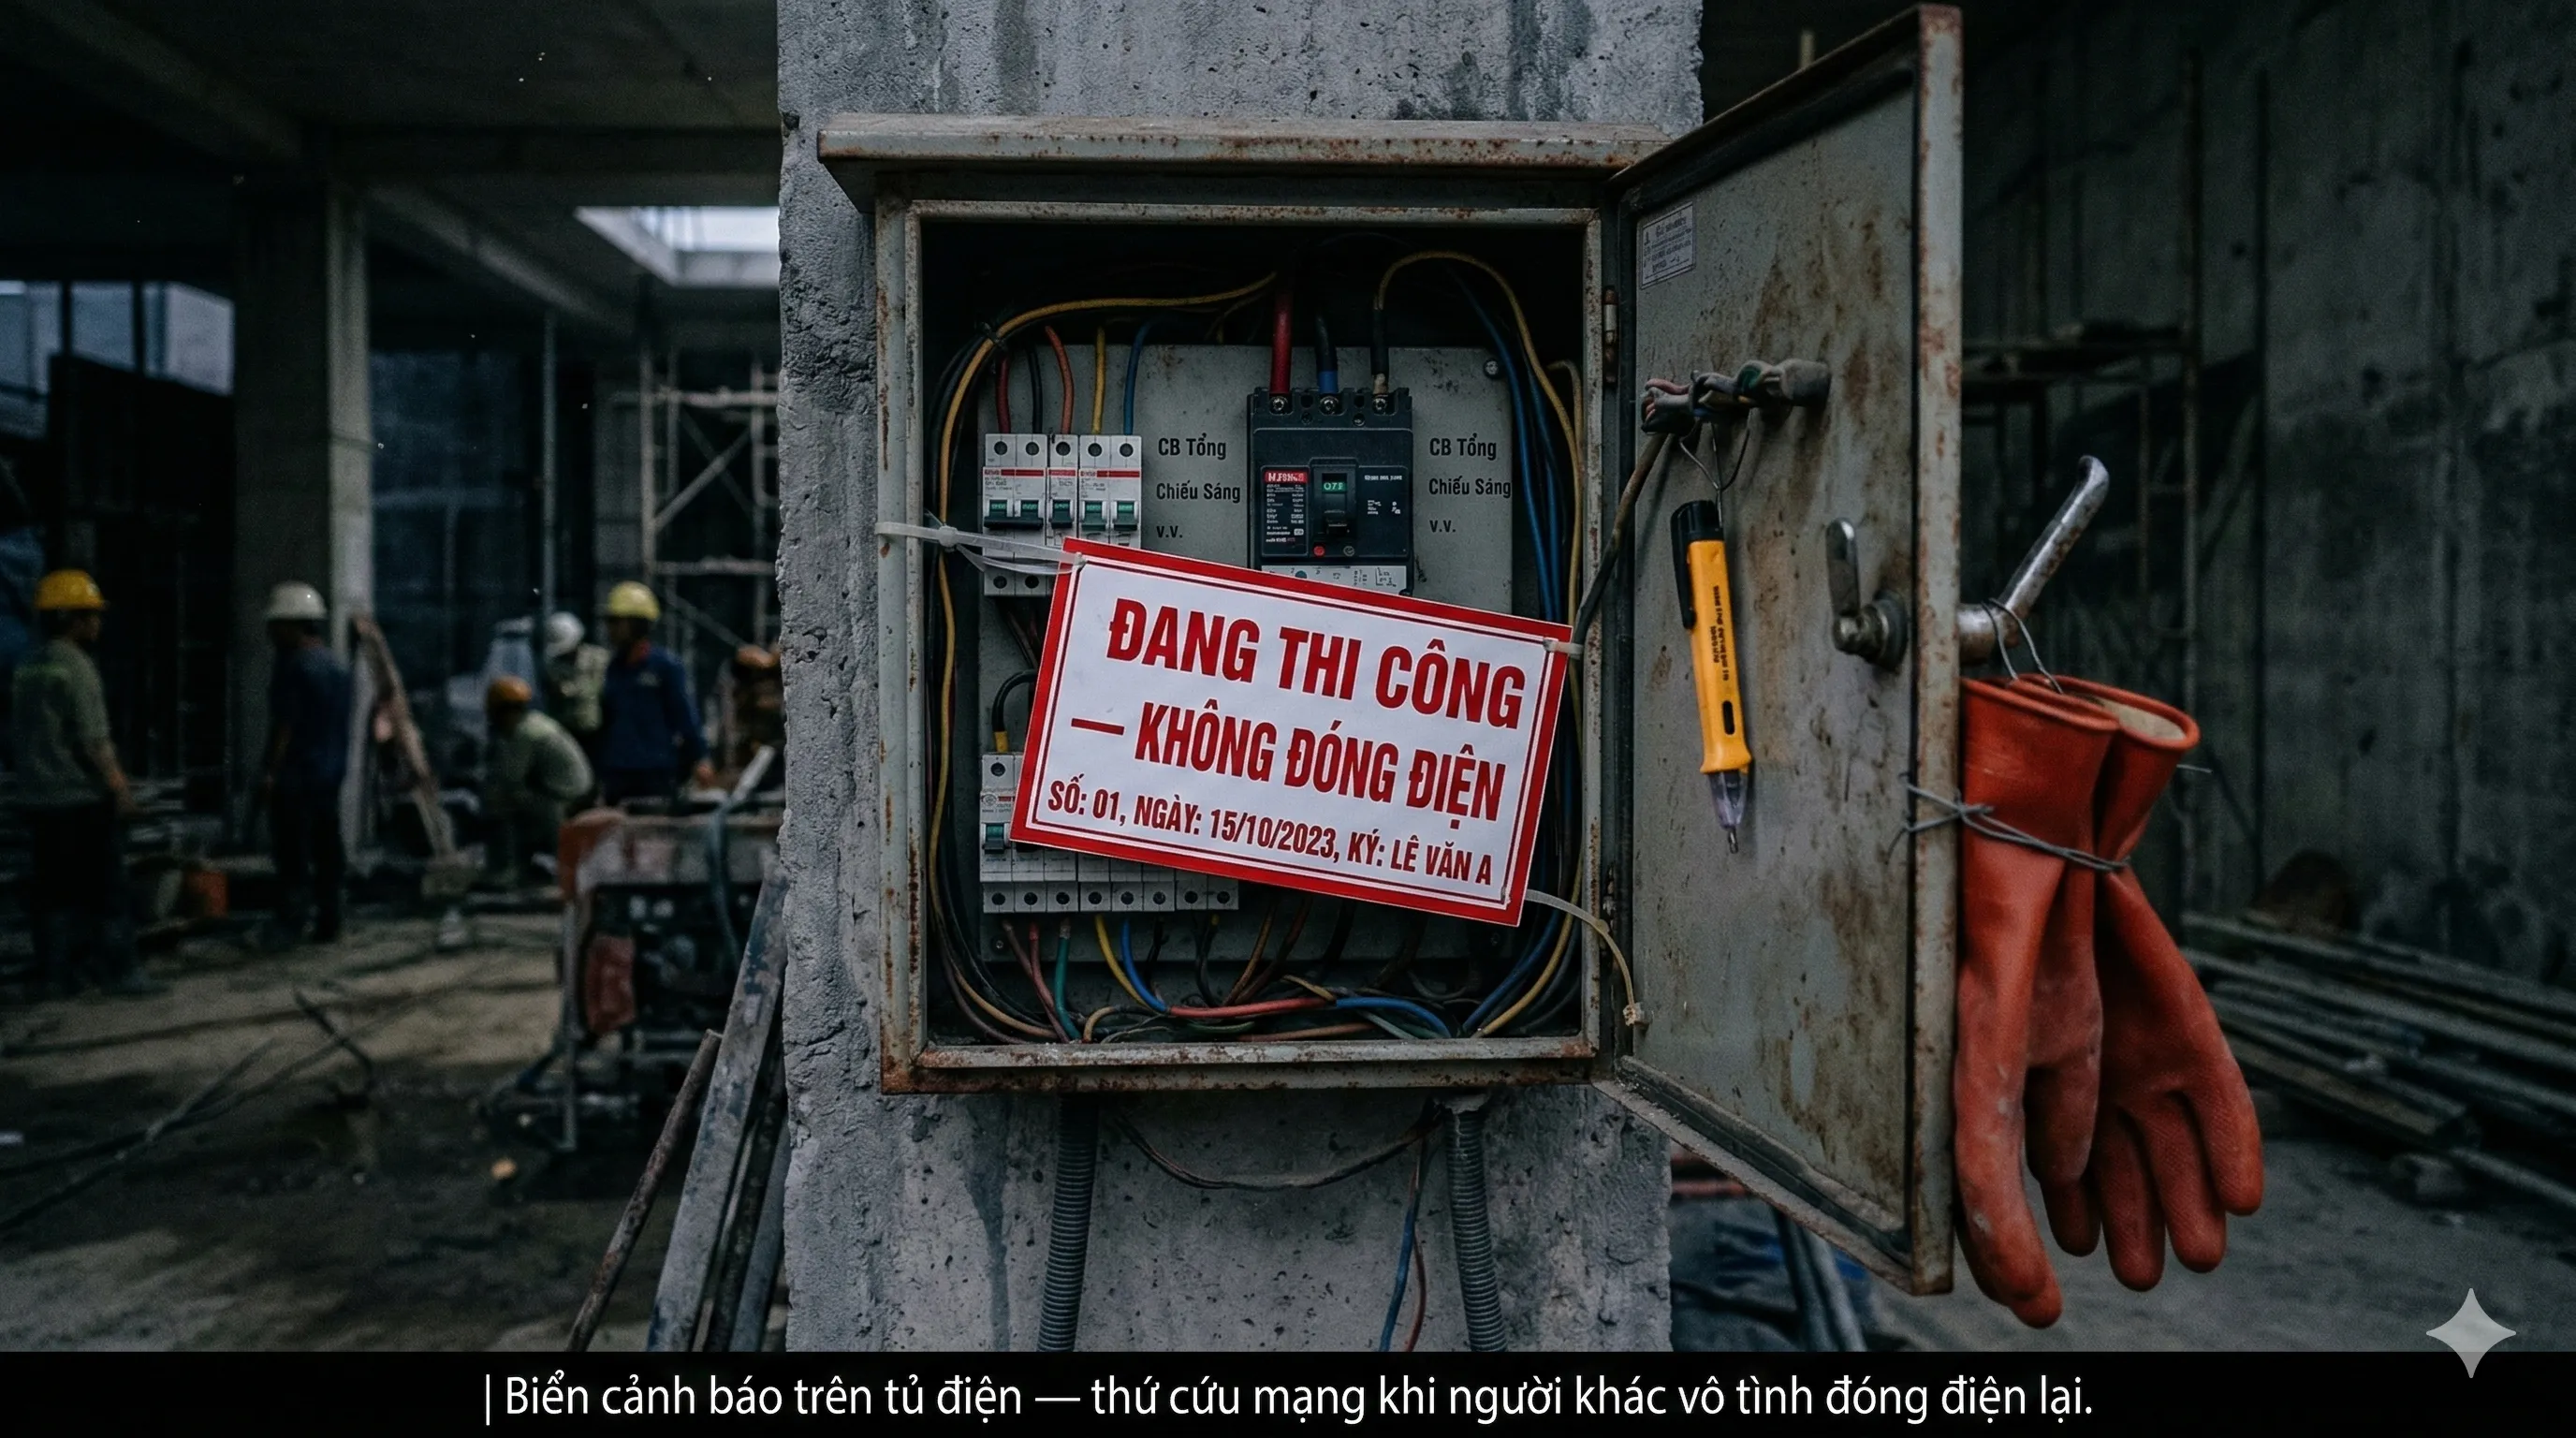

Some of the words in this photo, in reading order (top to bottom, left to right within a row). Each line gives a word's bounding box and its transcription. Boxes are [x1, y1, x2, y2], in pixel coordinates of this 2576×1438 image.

[1158, 437, 1181, 456] CB
[1185, 432, 1226, 461] Tổng
[1429, 437, 1452, 456] CB
[1456, 432, 1497, 461] Tổng
[1156, 479, 1198, 500] Chiếu
[1203, 482, 1240, 504] Sáng
[1428, 475, 1470, 495] Chiếu
[1106, 598, 1261, 683] ĐANG
[1278, 626, 1362, 701] THI
[1375, 638, 1526, 730] CÔNG
[1134, 699, 1278, 783] KHÔNG
[1283, 720, 1399, 804] ĐÓNG
[1405, 744, 1506, 830] ĐIỆN
[1047, 773, 1088, 815] SỐ:
[1092, 789, 1126, 827] 01,
[1133, 794, 1202, 836] NGÀY:
[1210, 809, 1340, 864] 15/10/2023,
[1346, 828, 1385, 867] KÝ:
[1390, 834, 1420, 873] LÊ
[1425, 841, 1473, 882] VĂN
[1474, 854, 1492, 886] A
